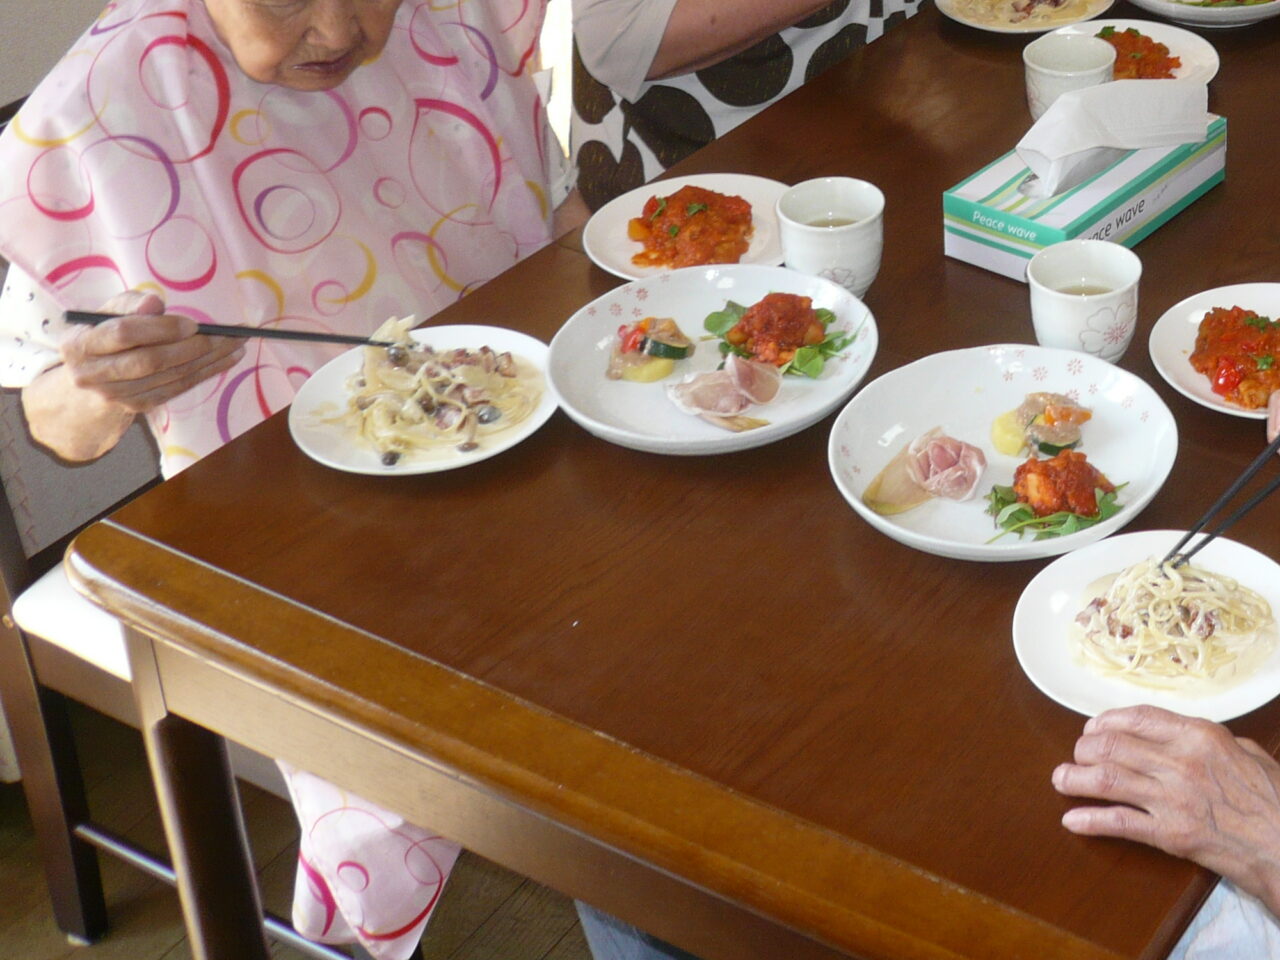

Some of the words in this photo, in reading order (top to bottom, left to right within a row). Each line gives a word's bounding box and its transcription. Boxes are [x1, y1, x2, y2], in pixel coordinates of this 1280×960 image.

[972, 210, 1005, 231] Peace
[1007, 224, 1037, 241] wave
[1088, 222, 1112, 240] ace
[1115, 199, 1145, 230] wave
